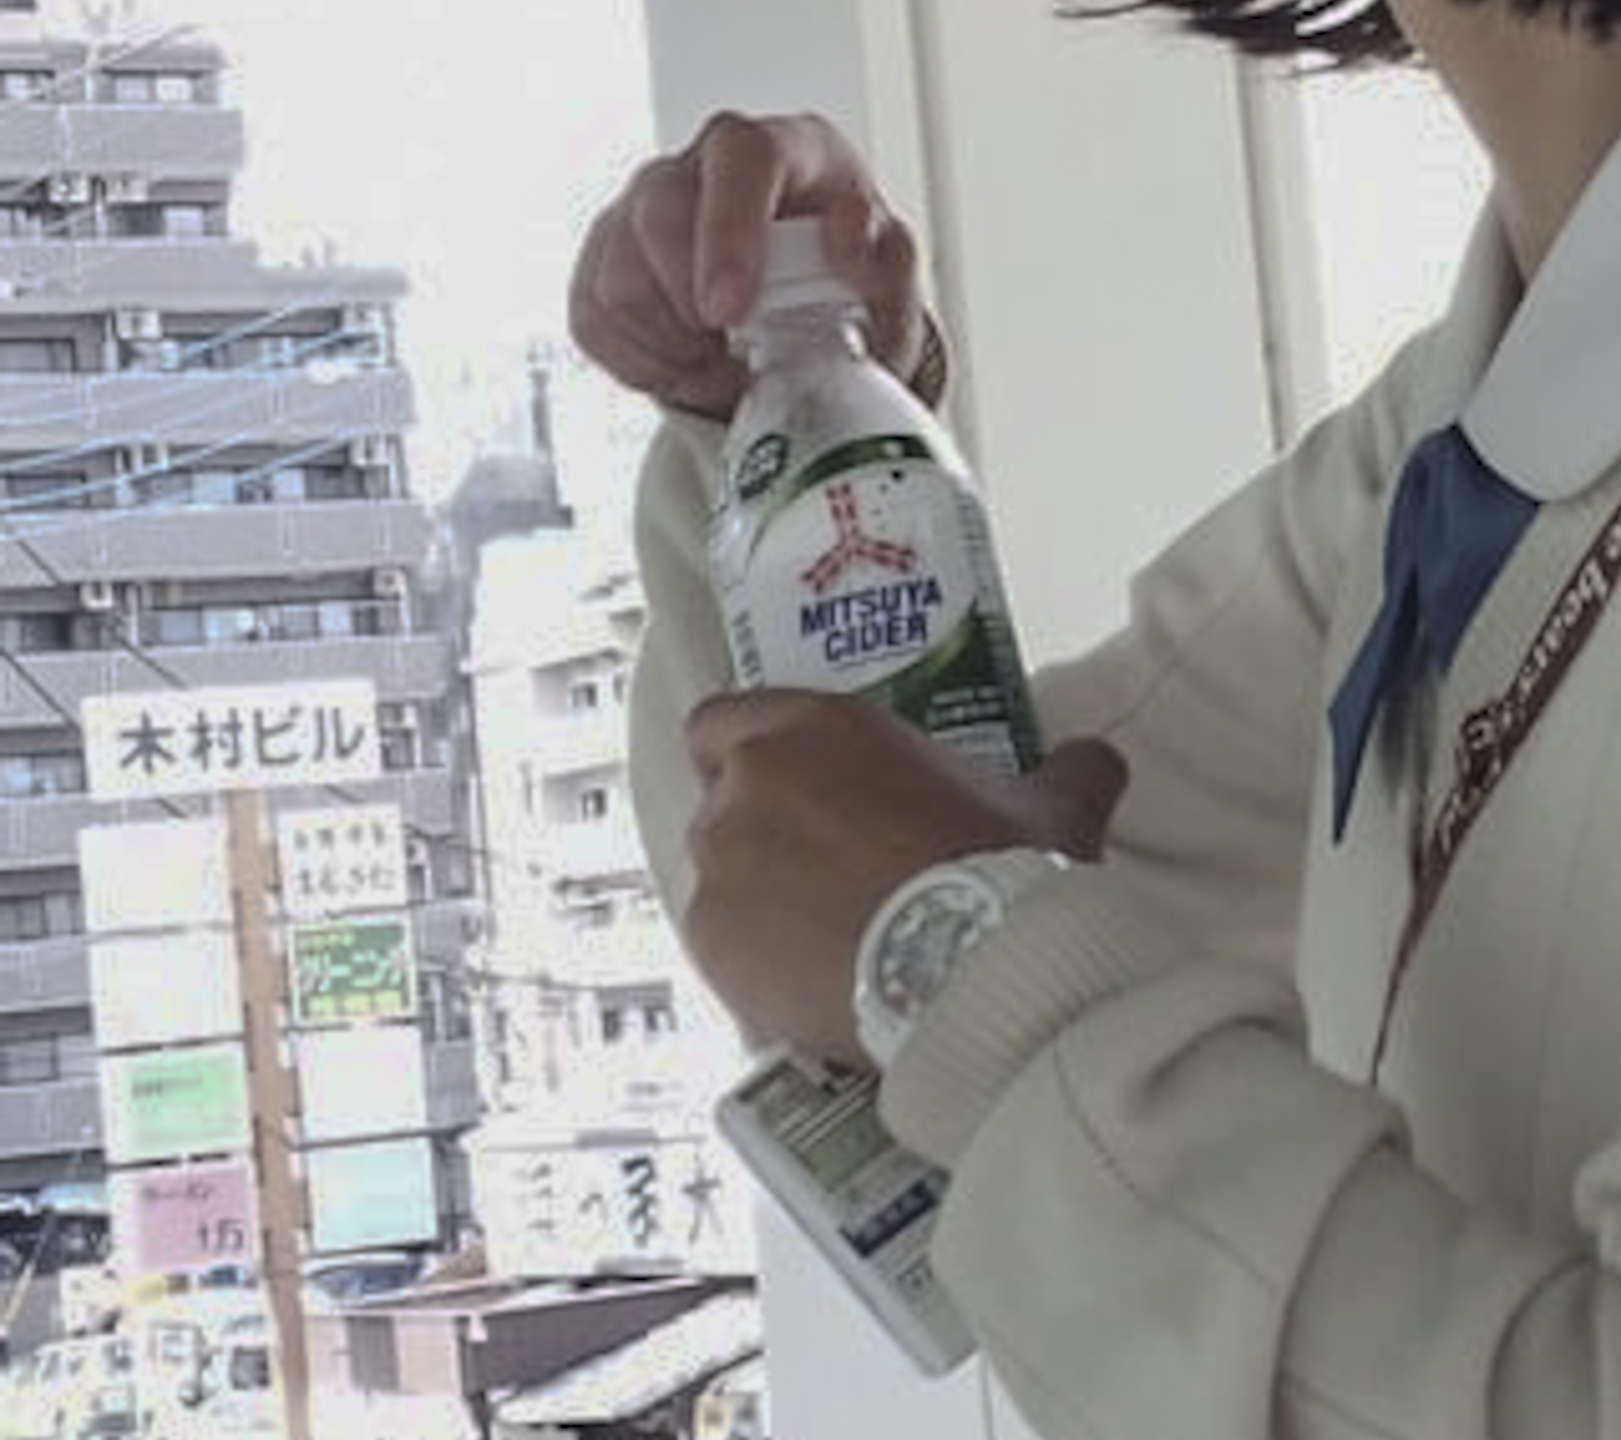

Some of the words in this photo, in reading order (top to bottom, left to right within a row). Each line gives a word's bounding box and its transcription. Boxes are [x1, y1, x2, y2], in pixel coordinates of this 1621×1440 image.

[801, 576, 943, 637] MITSUYA
[825, 612, 929, 662] CIDER
[118, 707, 367, 775] 木村ビル
